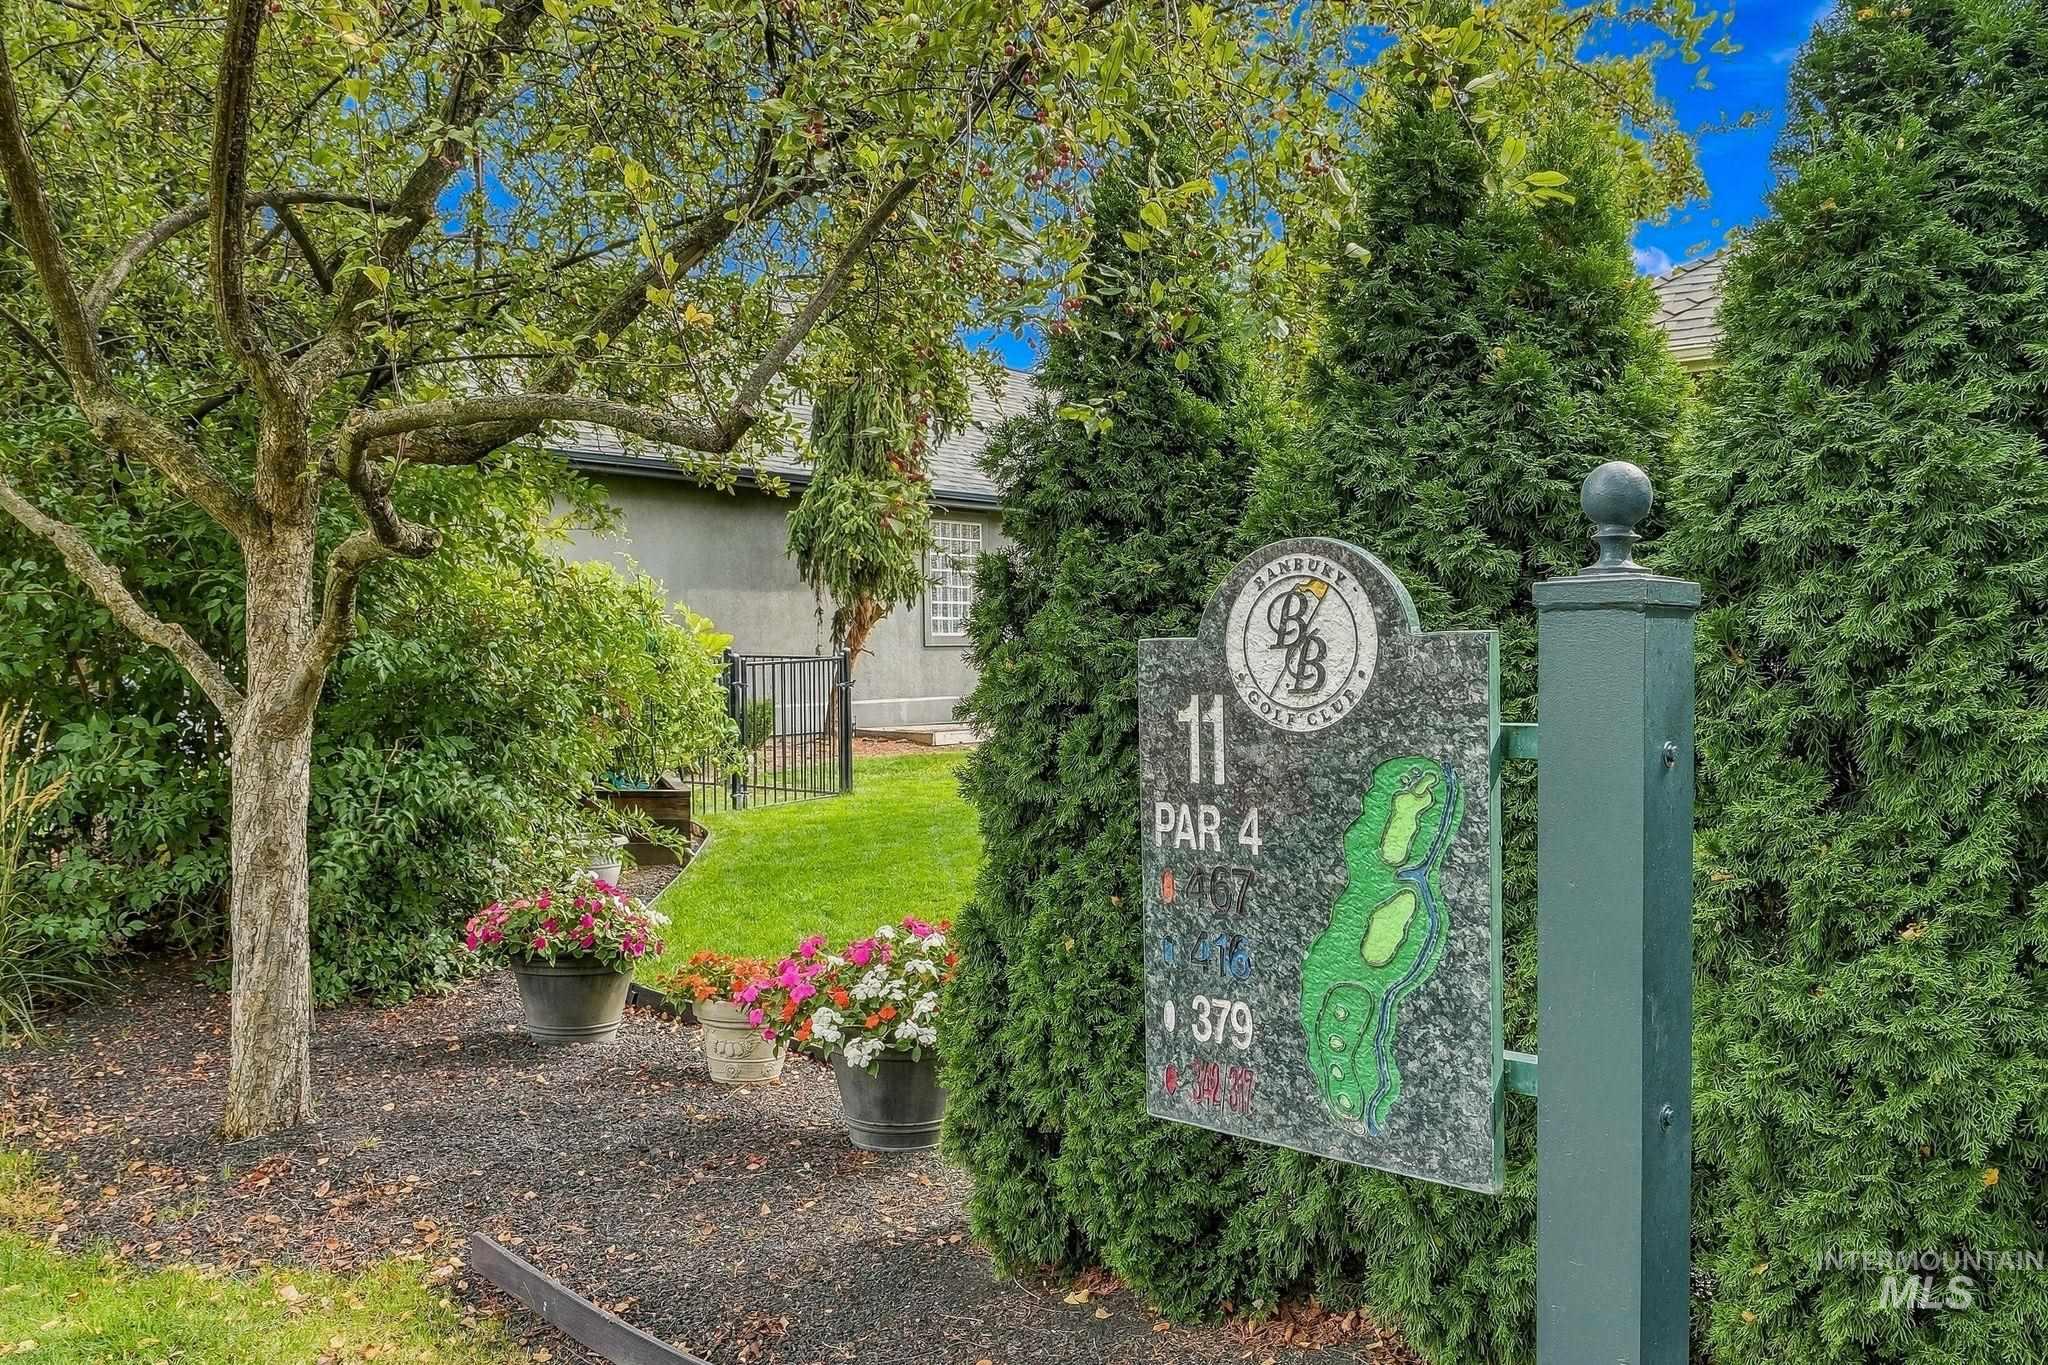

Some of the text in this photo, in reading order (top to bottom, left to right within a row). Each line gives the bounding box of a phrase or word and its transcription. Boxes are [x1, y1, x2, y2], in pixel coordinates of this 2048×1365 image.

[1253, 557, 1347, 592] BANBURY
[1248, 688, 1356, 727] GOLF CLUB
[1178, 694, 1225, 785] 11
[1155, 802, 1263, 856] PAR 4
[1185, 864, 1255, 917] 467
[1190, 931, 1252, 981] 416
[1191, 995, 1253, 1050] 379
